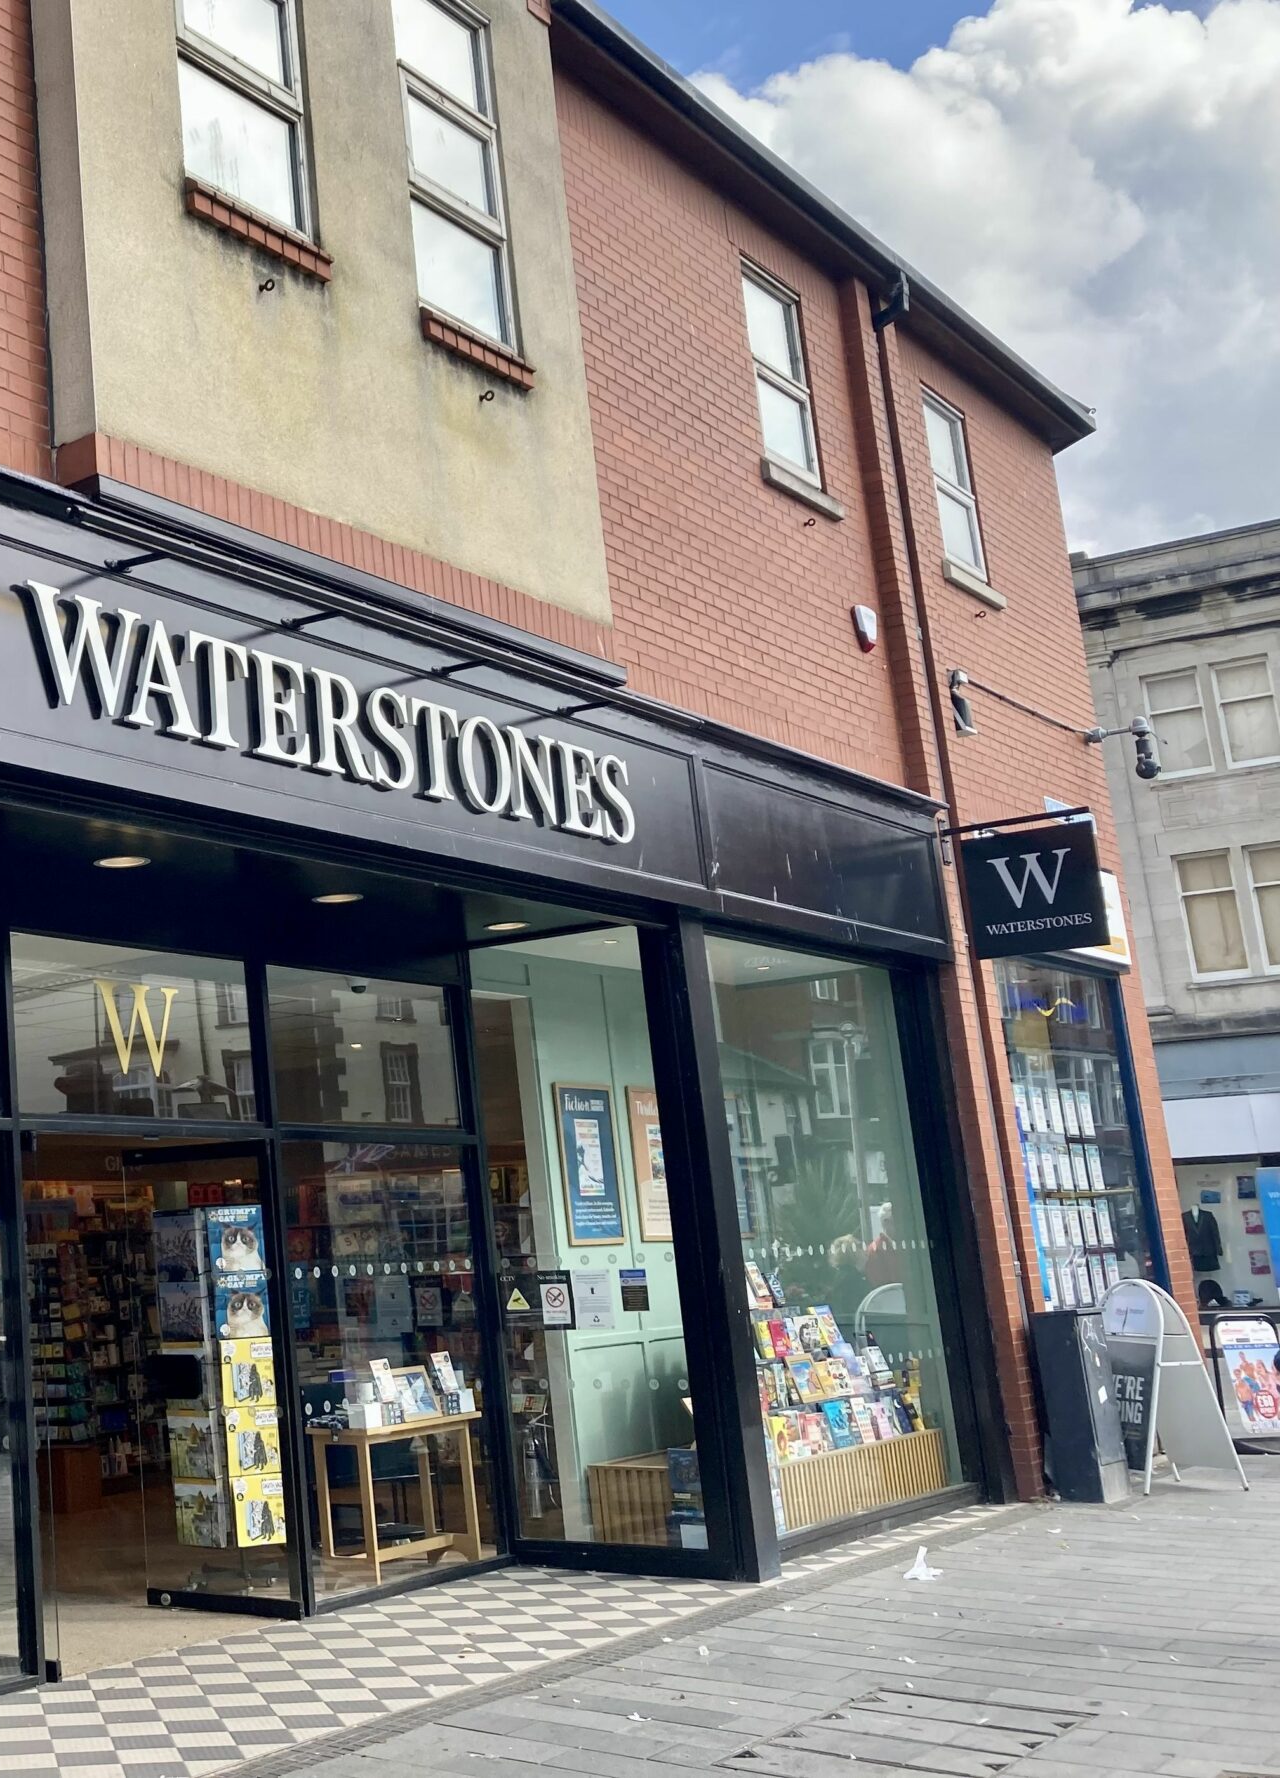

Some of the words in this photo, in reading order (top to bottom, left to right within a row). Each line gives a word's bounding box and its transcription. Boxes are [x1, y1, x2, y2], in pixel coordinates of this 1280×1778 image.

[22, 578, 636, 845] WATERSTONES
[986, 847, 1071, 909] W
[986, 912, 1093, 936] WATERSTONES
[93, 979, 179, 1077] W
[217, 1207, 257, 1215] GRUMPY
[219, 1215, 236, 1223] CAT
[227, 1281, 244, 1289] CAT
